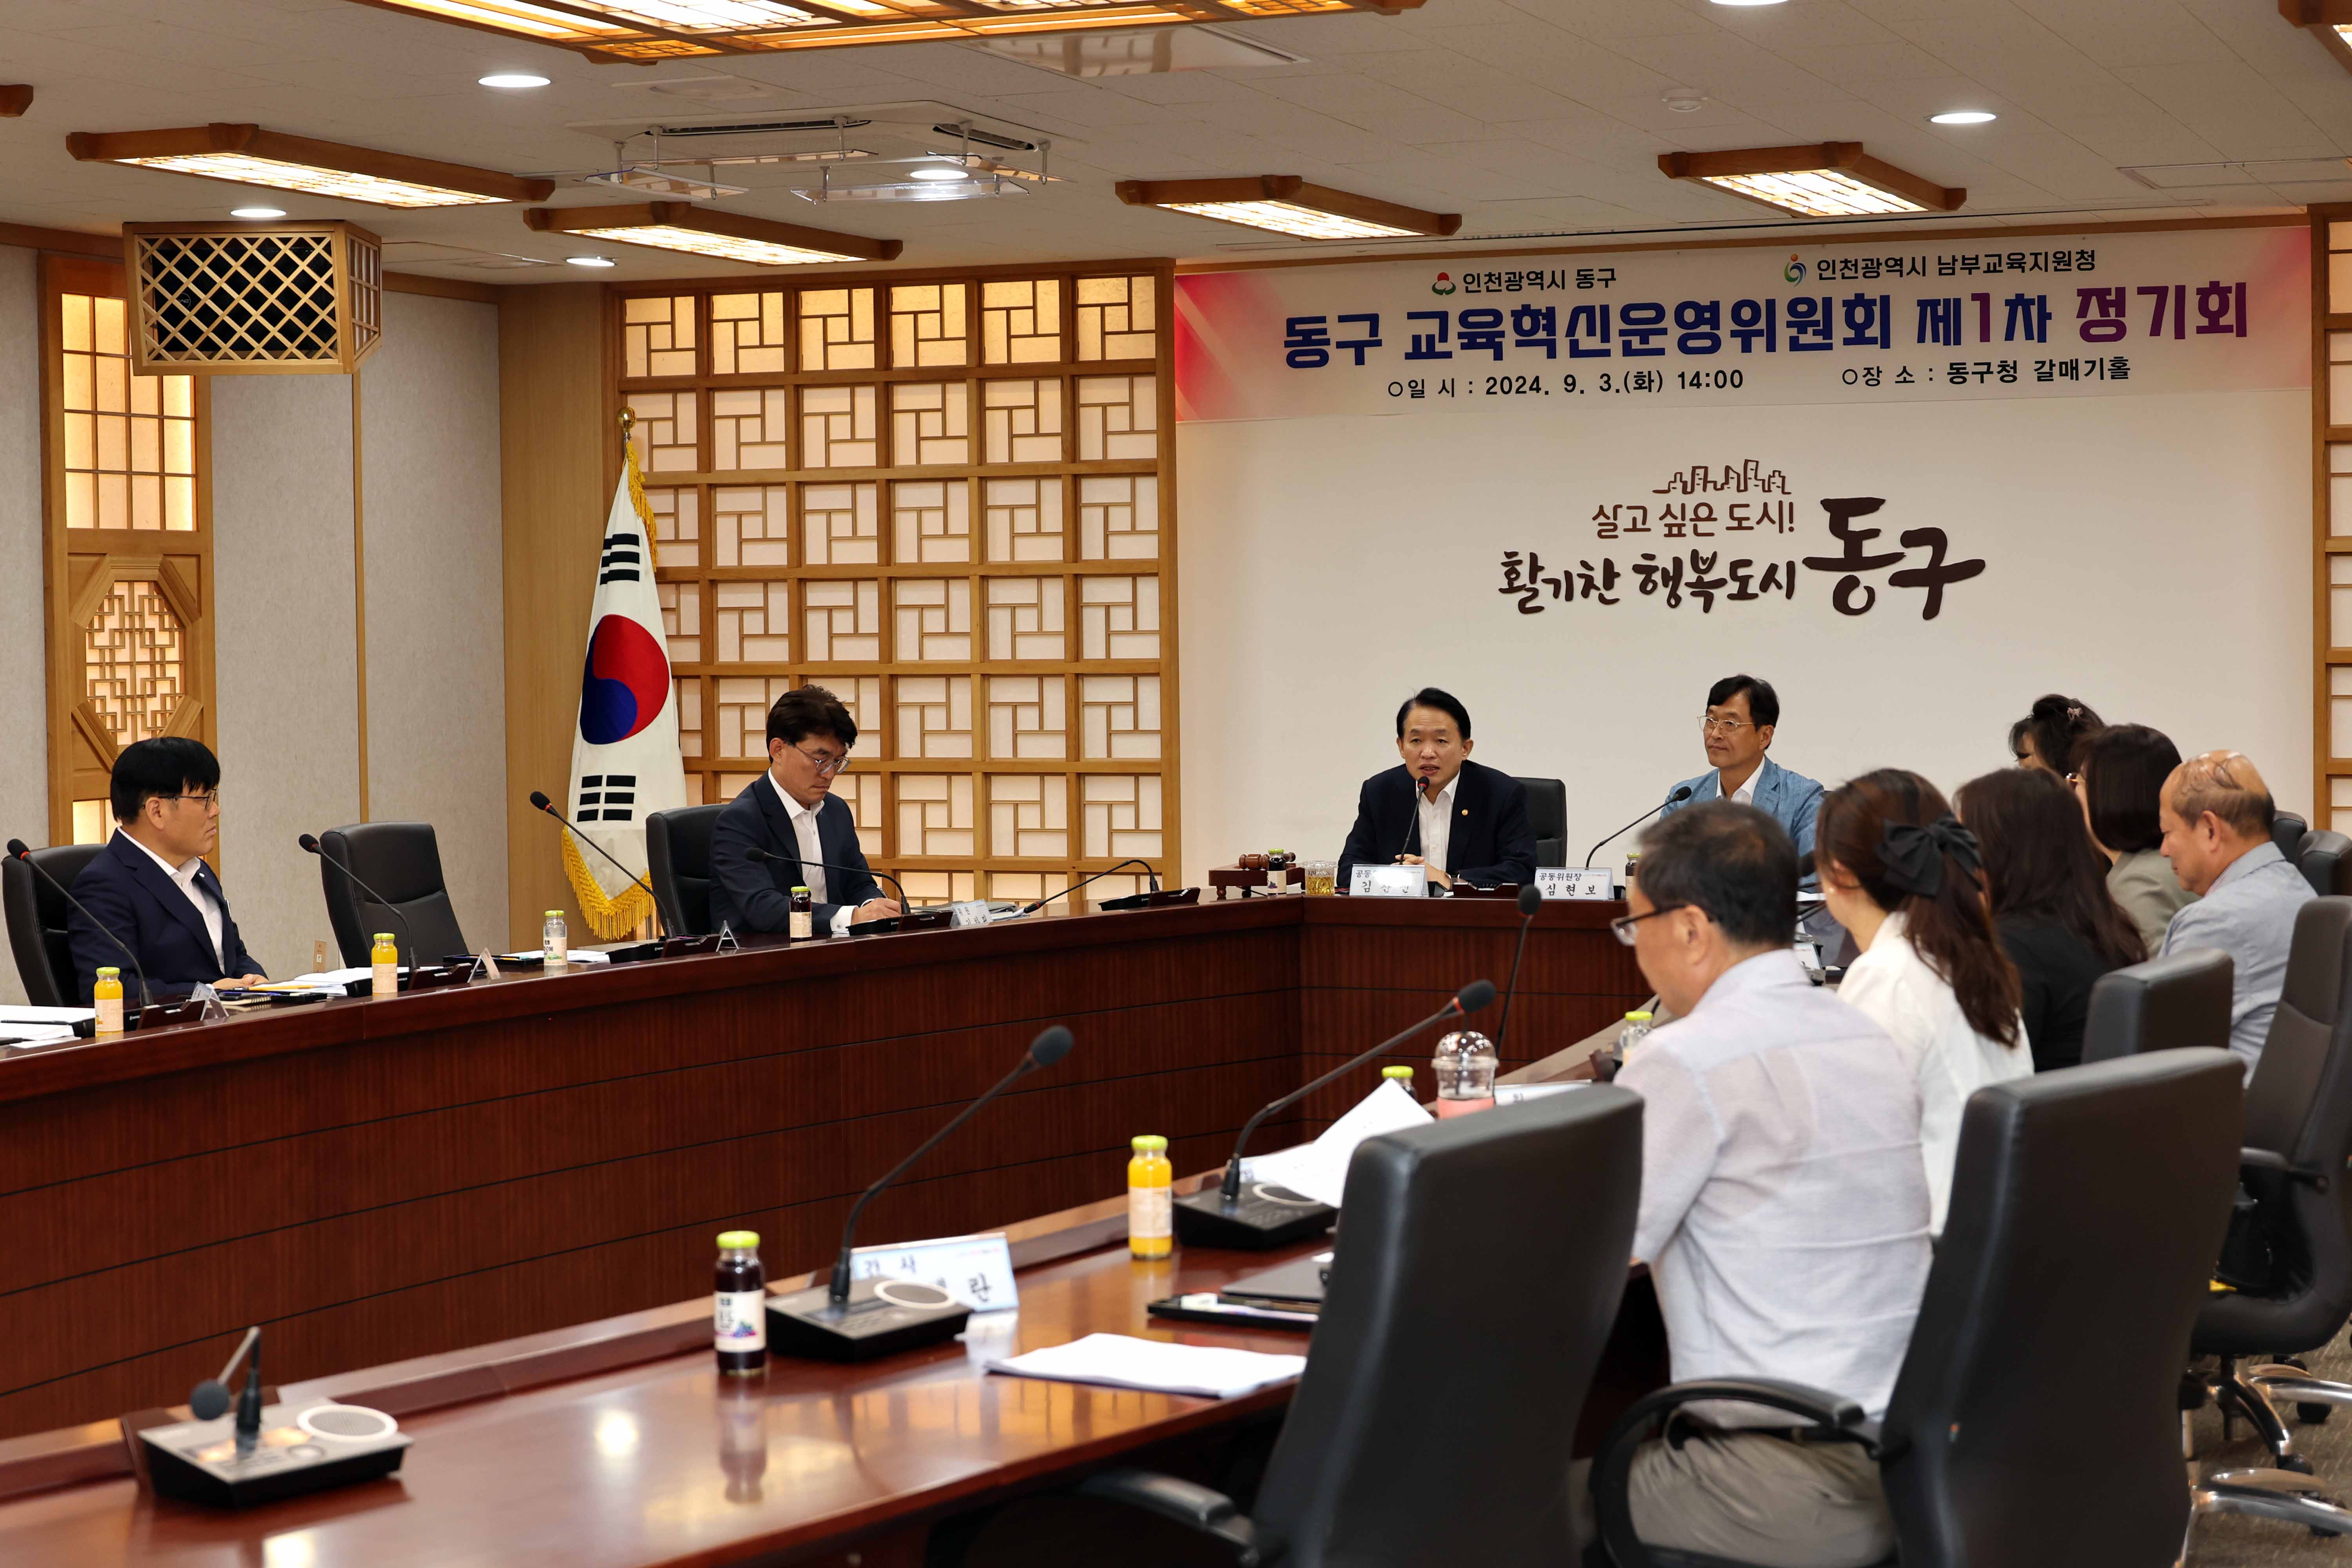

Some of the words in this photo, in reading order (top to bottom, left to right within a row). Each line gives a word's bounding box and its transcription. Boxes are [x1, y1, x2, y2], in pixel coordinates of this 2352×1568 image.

[1817, 255, 1926, 281] 인천광역시
[1937, 249, 2095, 276] 남부교육지원청
[1463, 269, 1565, 294] 인천광역시
[1575, 268, 1617, 289] 동구
[1283, 312, 1383, 369] 동구
[1404, 292, 1891, 360] 교육혁신운영위원회
[1916, 292, 2053, 346] 제1차
[2076, 280, 2247, 343] 정기회
[1486, 375, 1549, 395] 2024.
[1564, 374, 1584, 394] 9.
[1677, 369, 1743, 389] 14:00
[1947, 360, 2018, 385] 동구청
[2033, 356, 2131, 382] 갈매기홀
[1592, 504, 1651, 539] 살고
[1659, 502, 1718, 538] 싶은
[1725, 500, 1794, 534] 도시!
[1498, 551, 1621, 615] 활기찬
[1632, 548, 1796, 614] 행복도시
[1802, 497, 1986, 621] 동구
[1539, 873, 1582, 881] 공동위원장
